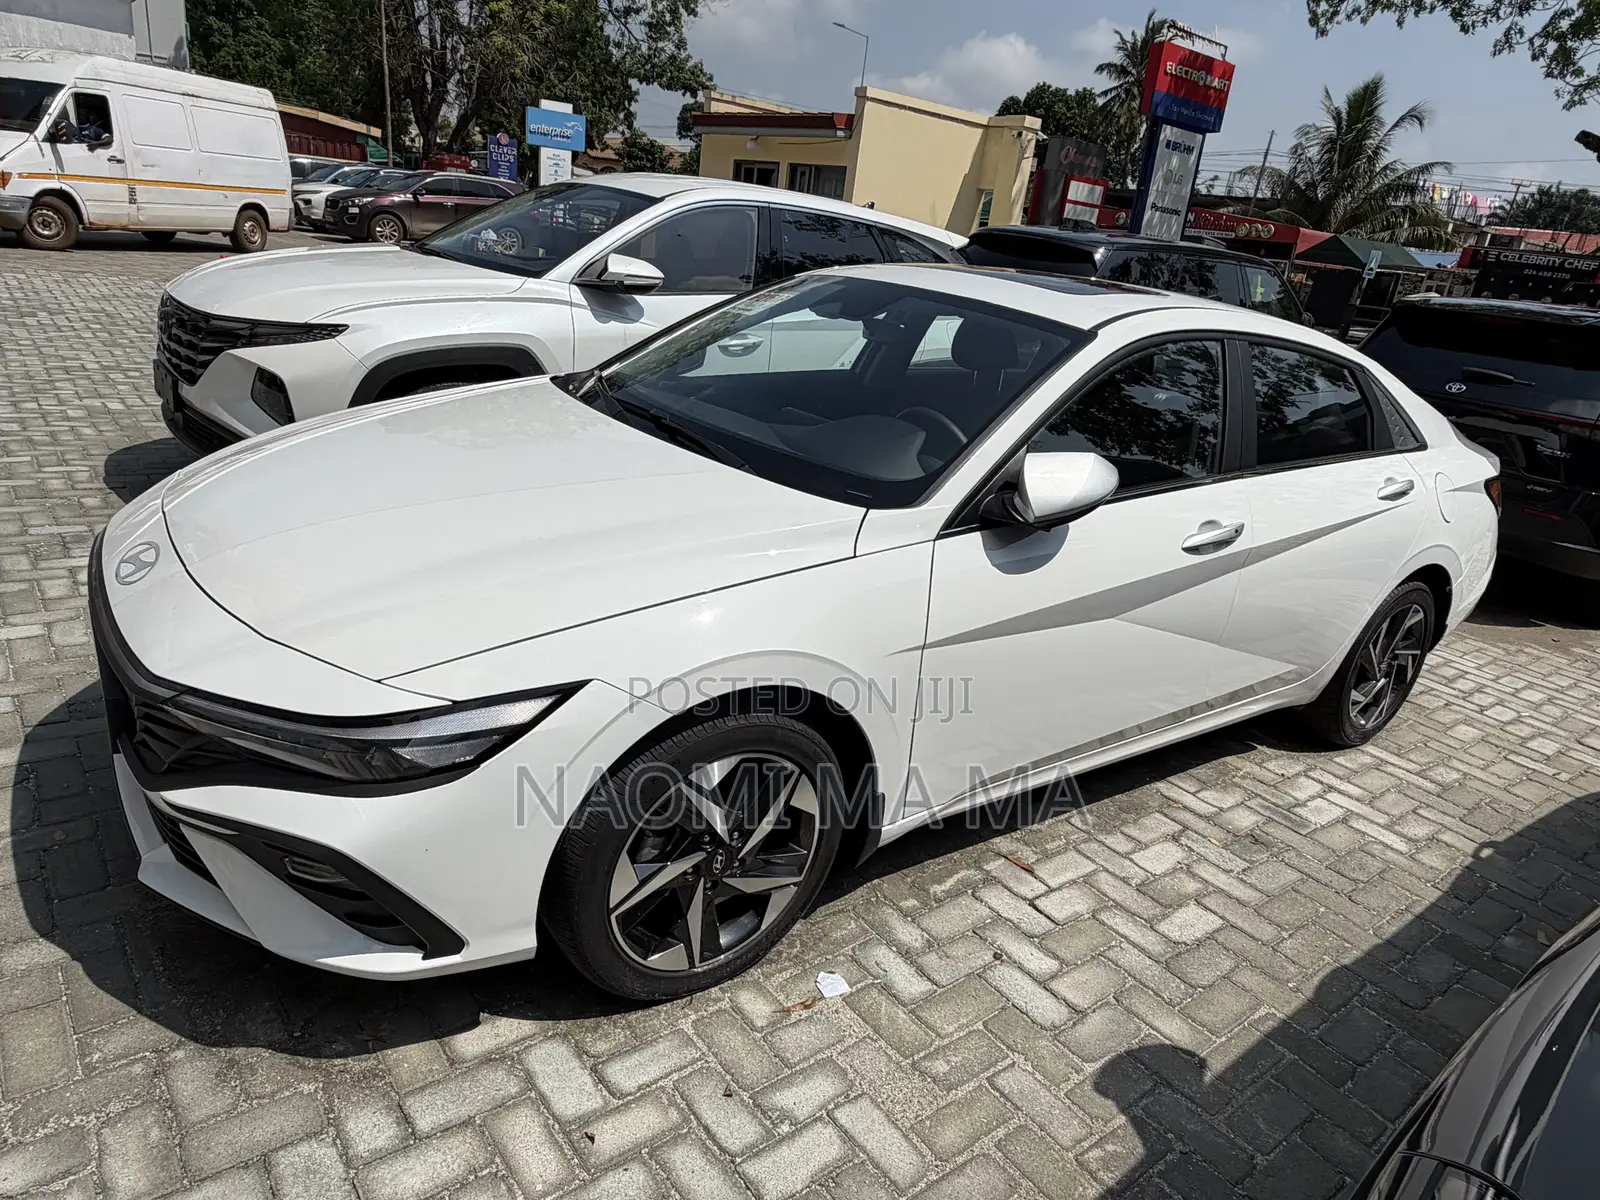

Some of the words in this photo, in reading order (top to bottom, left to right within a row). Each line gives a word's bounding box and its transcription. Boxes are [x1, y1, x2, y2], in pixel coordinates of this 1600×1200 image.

[530, 123, 573, 137] enterprise
[489, 144, 518, 156] CLEVER
[1171, 140, 1195, 156] BRÜHM
[492, 152, 515, 163] CLIPS
[1173, 172, 1184, 185] LG
[1150, 202, 1182, 217] Panasonic
[1499, 252, 1563, 267] CELEBRITY
[1564, 258, 1600, 271] CHEF
